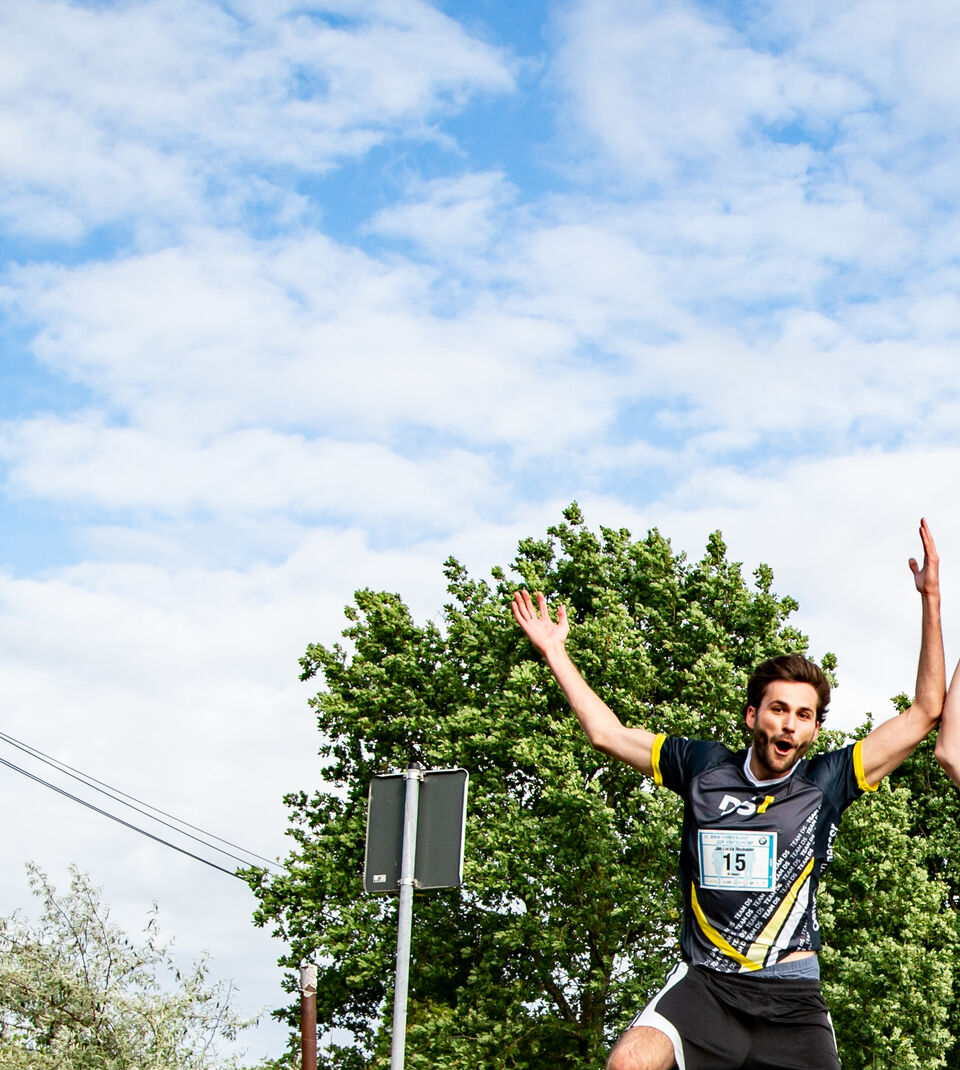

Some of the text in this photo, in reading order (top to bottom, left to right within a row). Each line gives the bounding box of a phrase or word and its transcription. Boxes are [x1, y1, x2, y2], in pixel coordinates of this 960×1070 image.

[790, 832, 801, 848] TEAM
[800, 825, 807, 834] DS
[790, 844, 802, 859] TEAM
[800, 836, 808, 845] DS
[723, 853, 746, 871] 15
[782, 849, 790, 858] DS
[782, 866, 794, 881] TEAM
[792, 859, 801, 867] DS
[800, 842, 811, 857] TEAM
[782, 860, 790, 869] DS
[790, 873, 798, 881] DS
[797, 854, 809, 871] TEAM
[734, 905, 747, 920] TEAM
[744, 898, 753, 907] DS
[735, 916, 748, 931] TEAM
[745, 908, 753, 918] DS
[752, 893, 766, 907] TEAM
[746, 913, 759, 928] TEAM
[756, 907, 764, 916] DS
[763, 890, 776, 905] TEAM
[755, 921, 763, 930] DS
[762, 903, 776, 920] TEAM
[772, 896, 781, 905] DS
